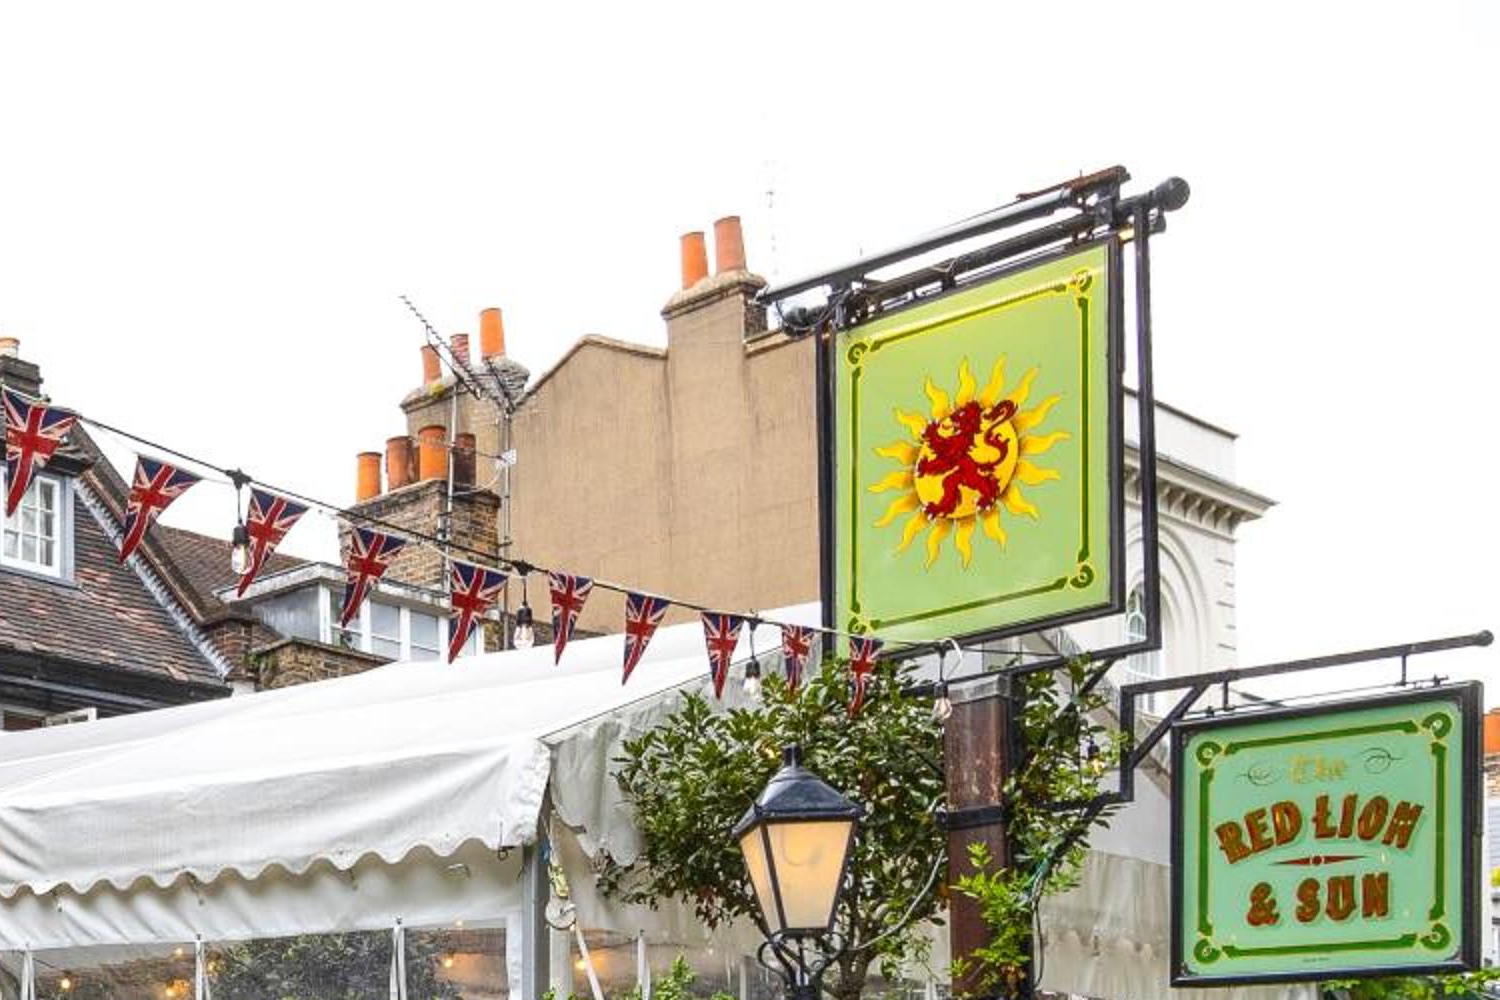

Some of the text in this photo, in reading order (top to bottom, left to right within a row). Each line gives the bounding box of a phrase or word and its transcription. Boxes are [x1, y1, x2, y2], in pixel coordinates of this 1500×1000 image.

[1215, 793, 1424, 864] RED LION
[1247, 872, 1389, 926] & SUN
